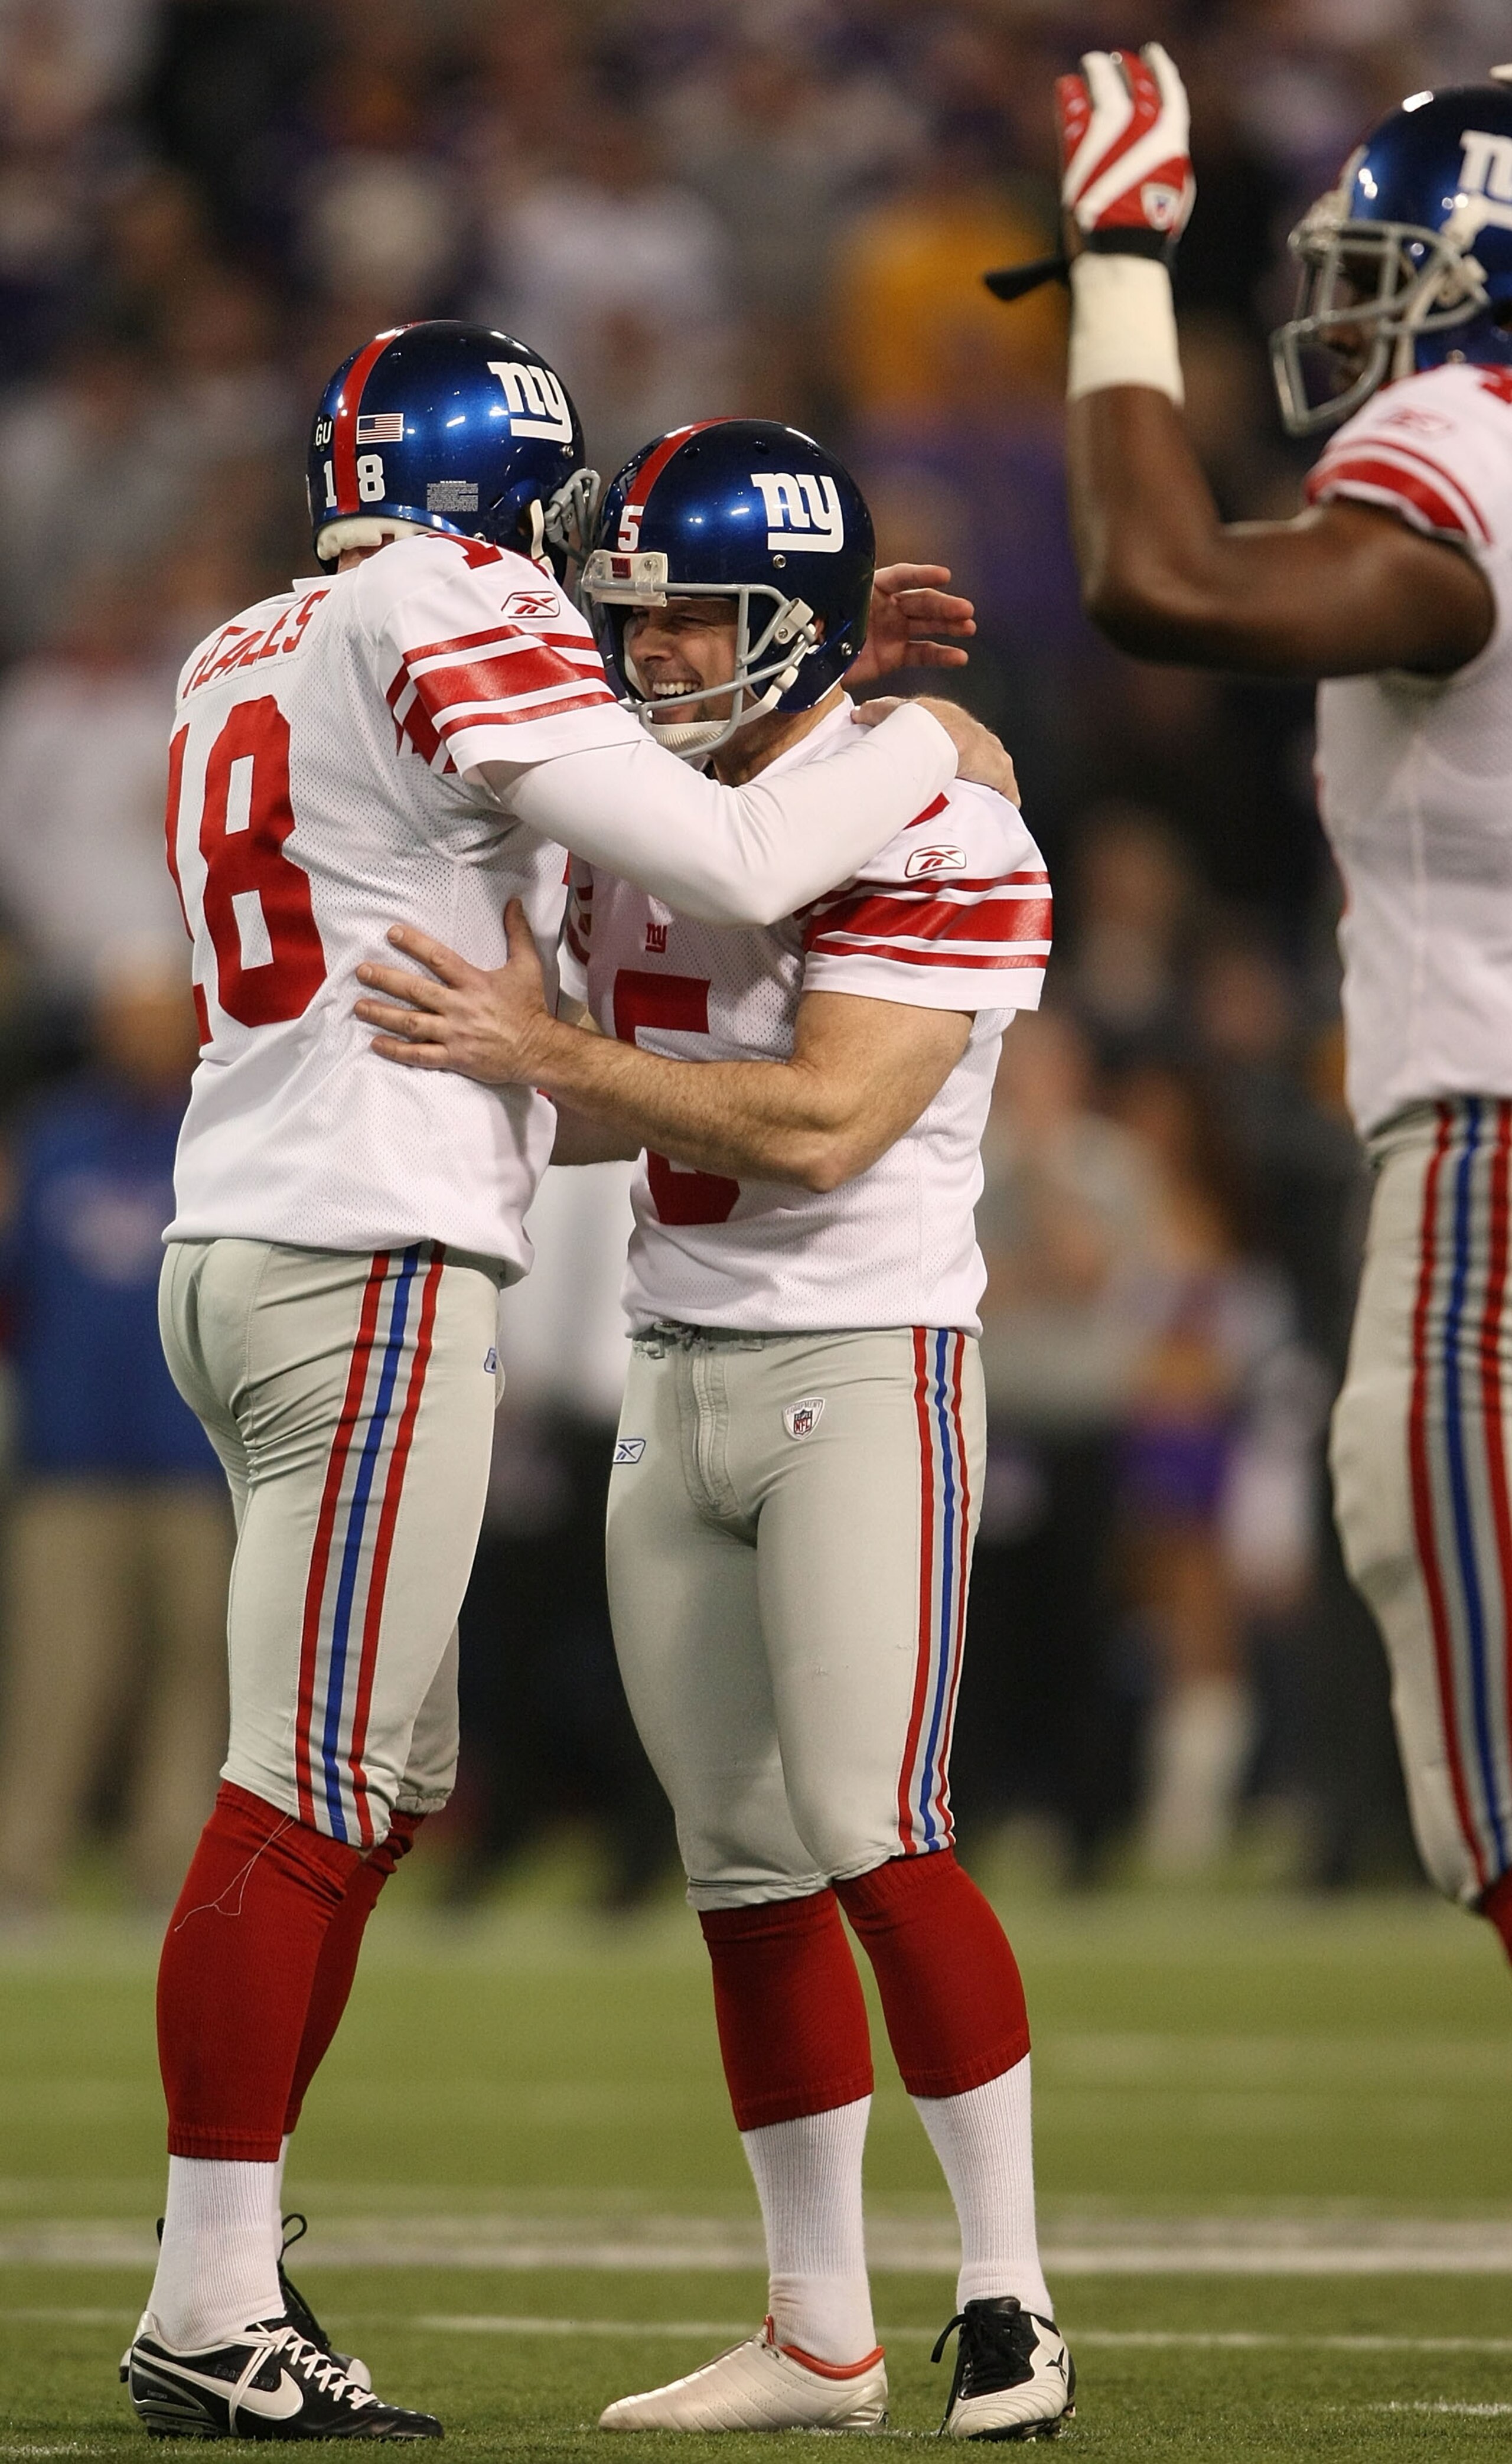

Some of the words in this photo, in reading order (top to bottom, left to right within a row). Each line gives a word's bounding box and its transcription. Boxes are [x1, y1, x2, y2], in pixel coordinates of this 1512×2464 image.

[315, 421, 333, 446] GU
[618, 505, 644, 552] 5
[795, 1419, 811, 1432] NFL
